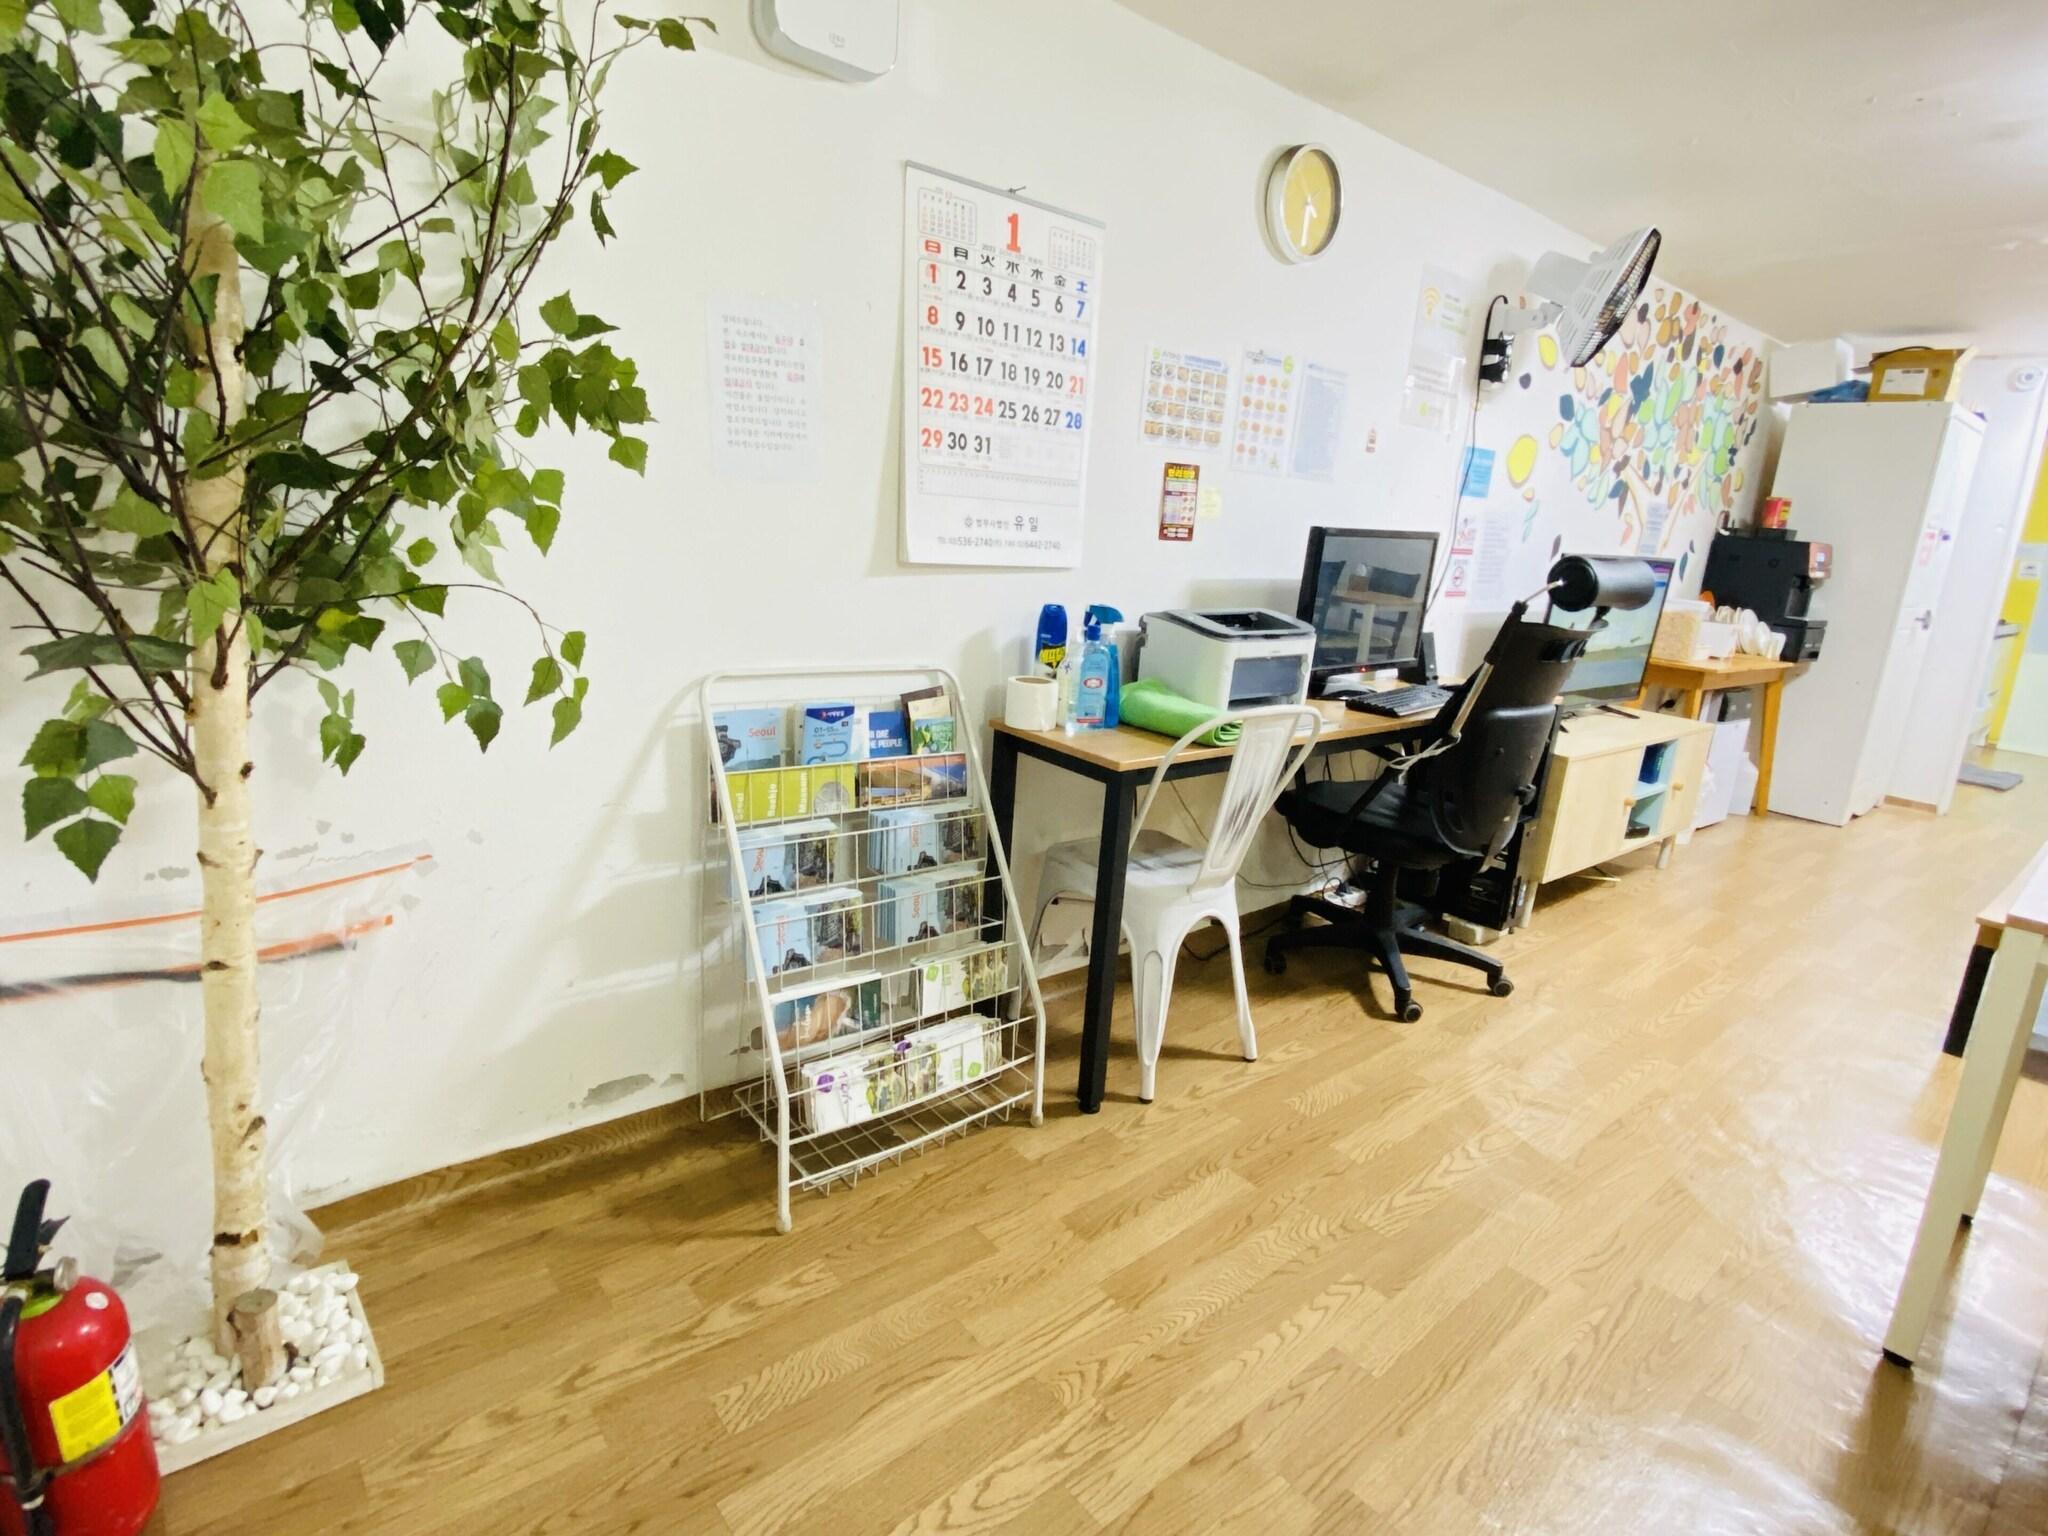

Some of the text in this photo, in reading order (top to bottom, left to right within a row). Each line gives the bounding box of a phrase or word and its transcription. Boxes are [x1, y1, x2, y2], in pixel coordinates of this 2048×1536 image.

[1006, 212, 1022, 254] 1
[924, 239, 942, 254] 日
[953, 246, 969, 261] 月
[980, 254, 995, 268] 火
[1005, 260, 1020, 275] 水
[1030, 268, 1044, 281] 木
[1054, 274, 1067, 288] 金
[1076, 280, 1088, 294] 土
[928, 263, 1086, 319] 1 2 3 4 5 6 7
[927, 305, 1086, 357] 8 9 10 11 12 13 14
[922, 345, 1084, 396] 15 16 17 18 19 20 21
[920, 386, 1083, 430] 22 23 24 25 26 27 28
[920, 427, 991, 455] 29 30 31
[748, 726, 776, 737] Seoul
[878, 738, 902, 748] PEOPLE
